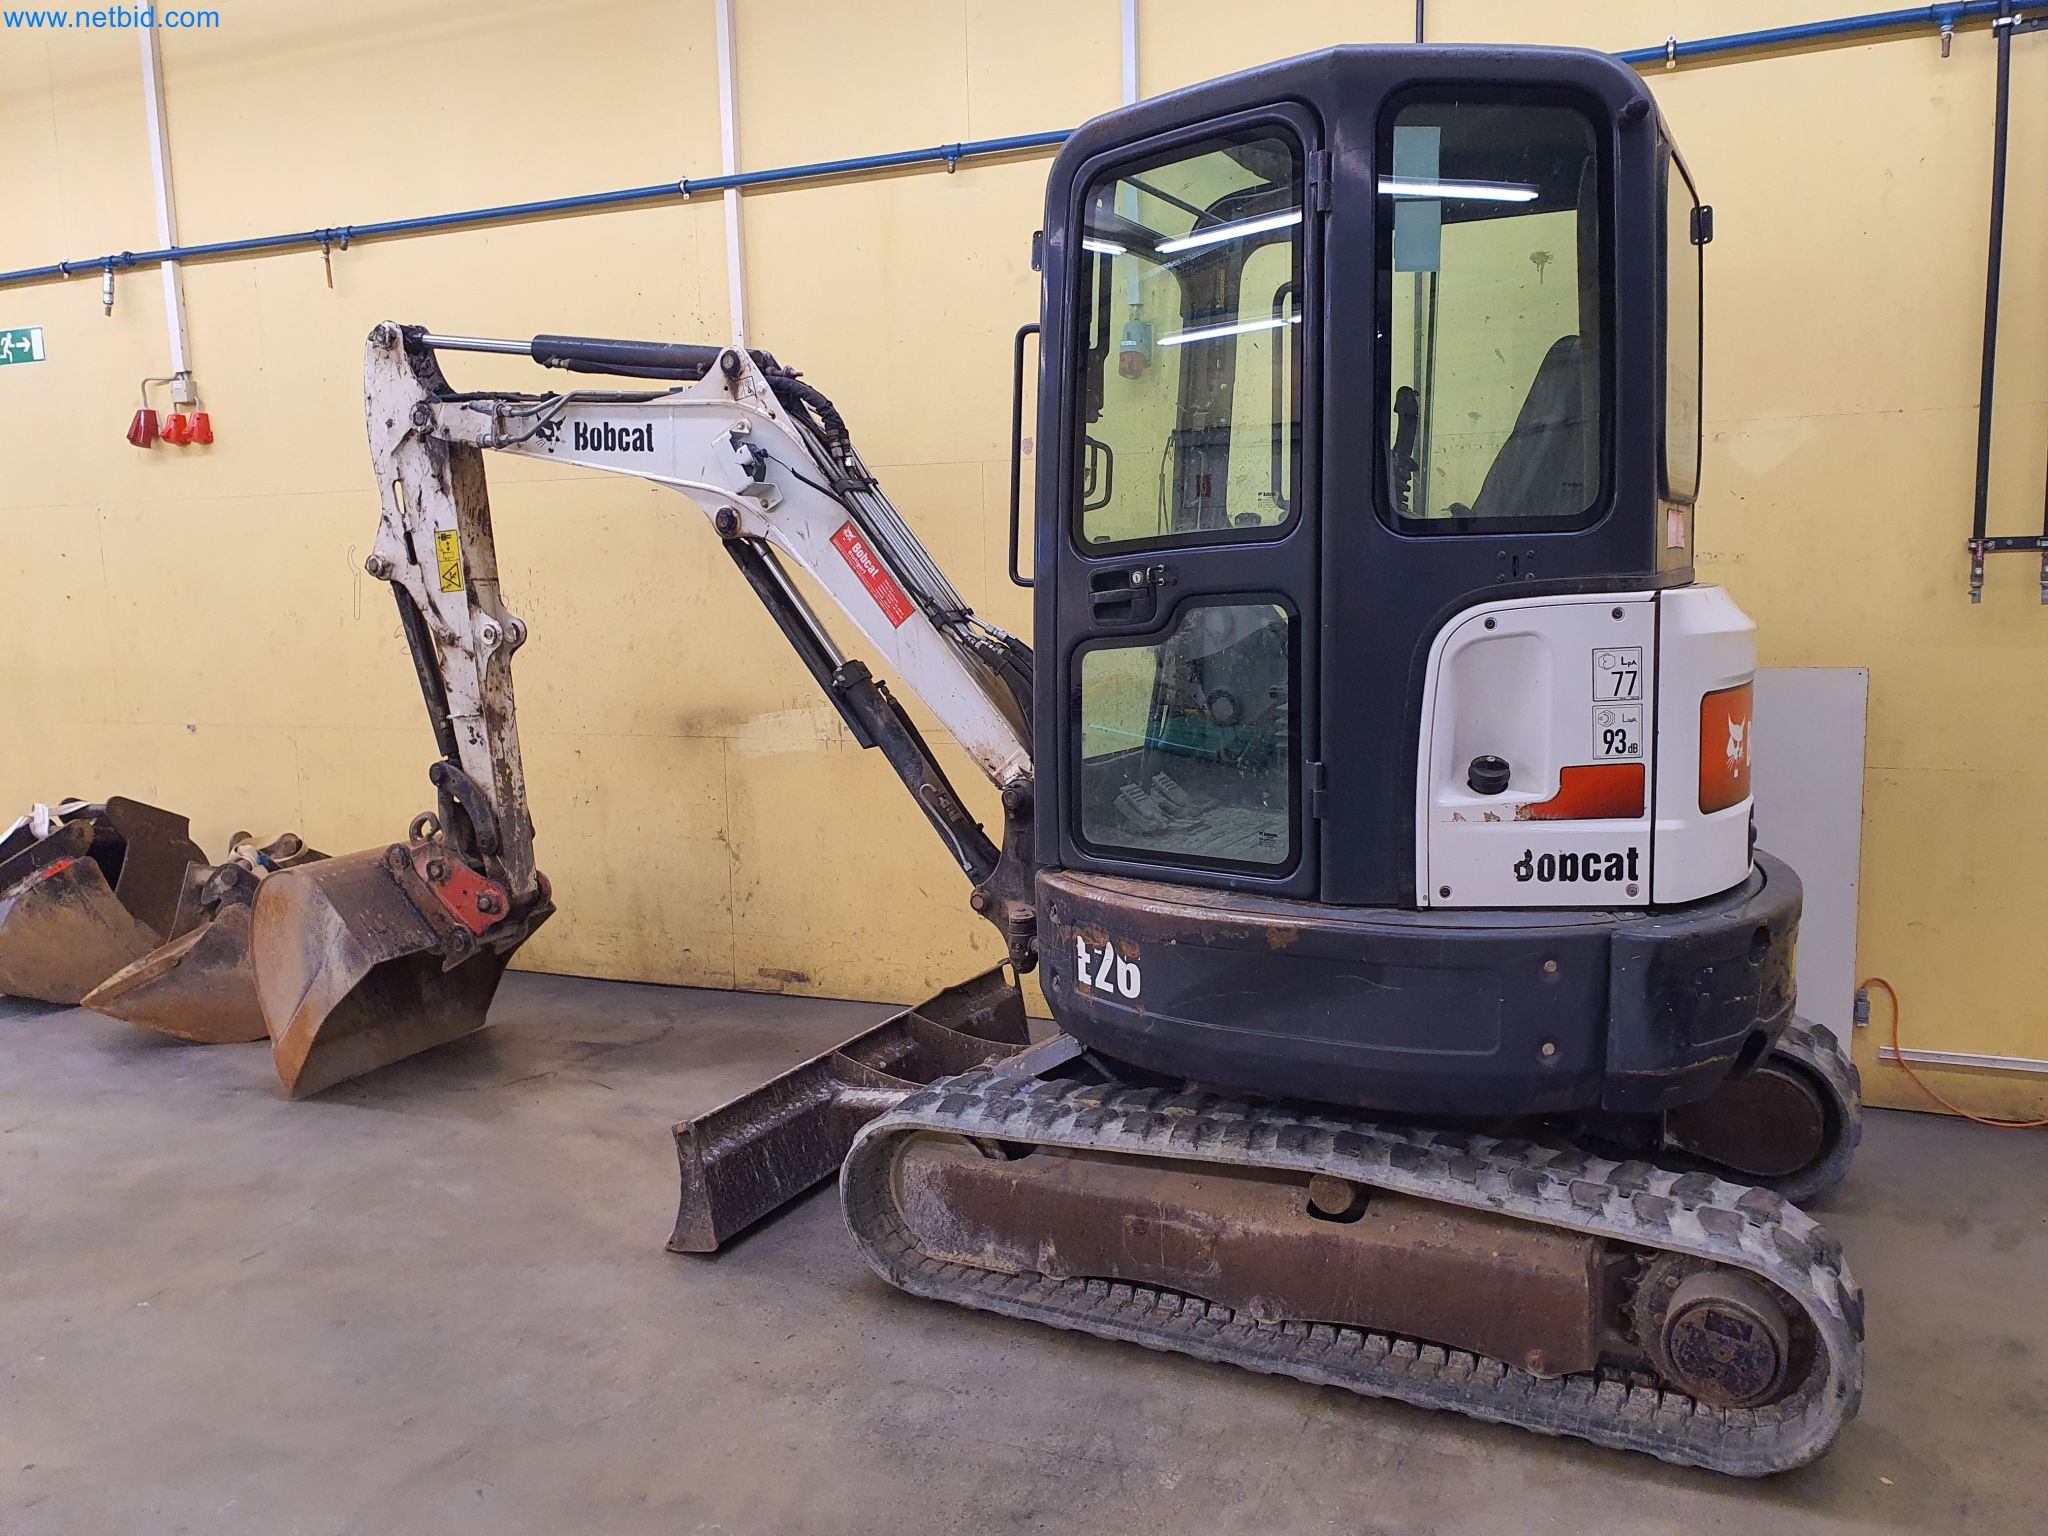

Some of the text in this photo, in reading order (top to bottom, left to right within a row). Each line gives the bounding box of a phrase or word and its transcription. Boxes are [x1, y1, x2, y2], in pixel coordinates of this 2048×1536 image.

[574, 421, 654, 452] Bobcat
[852, 543, 879, 577] Bobcat
[1611, 671, 1637, 696] 77
[1603, 729, 1638, 754] 93 dB
